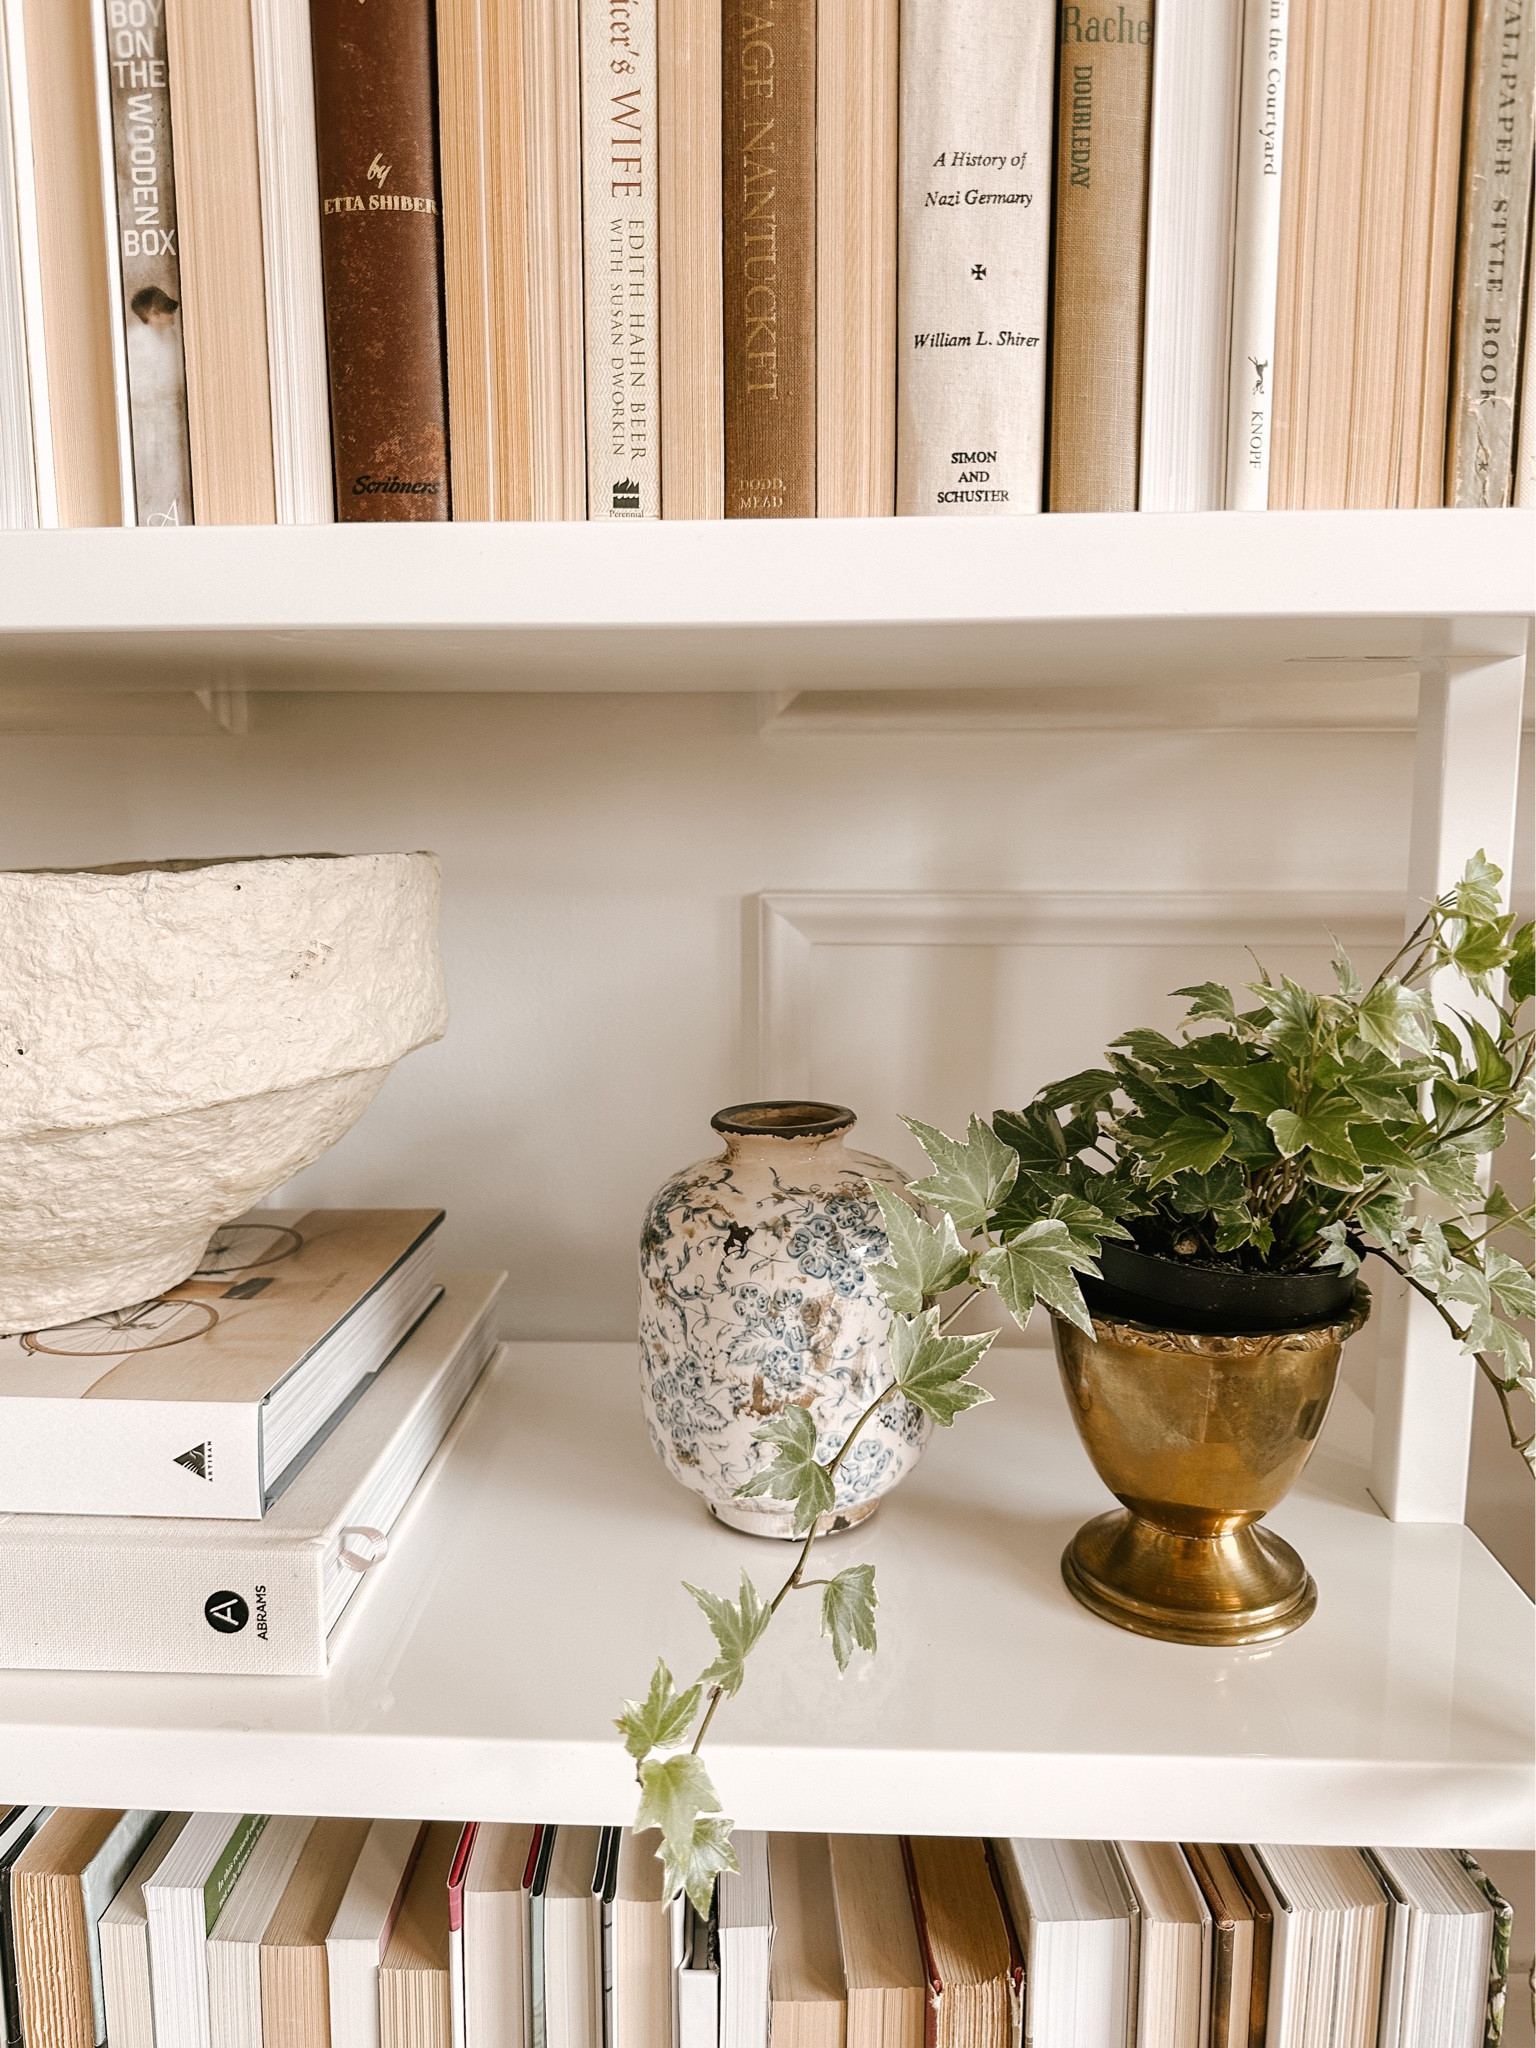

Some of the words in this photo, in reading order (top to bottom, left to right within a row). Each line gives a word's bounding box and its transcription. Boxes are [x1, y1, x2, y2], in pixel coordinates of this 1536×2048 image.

[110, 0, 163, 28] BOY
[1270, 0, 1285, 20] in
[116, 30, 156, 58] ON
[741, 0, 775, 100] AGE
[1268, 28, 1283, 61] the
[112, 60, 166, 88] THE
[610, 86, 642, 198] WIFE
[1070, 65, 1093, 189] DOUBLEDAY
[1259, 68, 1282, 176] Courtyard
[127, 93, 160, 225] WOODEN
[366, 152, 393, 189] by
[933, 152, 946, 167] A
[951, 151, 1007, 170] History
[1011, 152, 1028, 170] of
[324, 195, 366, 215] ETTA
[369, 194, 439, 215] SHIBER
[924, 191, 961, 207] Nazi
[965, 189, 1033, 208] Germany
[123, 229, 177, 257] BOX
[610, 218, 623, 272] WITH
[629, 220, 645, 297] EDITH
[742, 118, 779, 400] NANTUCKET
[1486, 200, 1508, 292] STYLE
[610, 283, 624, 346] SUSAN
[914, 332, 972, 349] William
[976, 331, 992, 346] L.
[997, 331, 1040, 347] Shirer
[630, 314, 646, 387] HAHN
[1480, 317, 1502, 408] BOOK
[611, 357, 625, 456] DWORKIN
[630, 403, 647, 460] BEER
[951, 451, 997, 464] SIMON
[1249, 411, 1264, 469] KNOPF
[937, 490, 1009, 503] SCHUSTER
[958, 471, 990, 483] AND
[609, 510, 644, 518] Perennial
[255, 1585, 268, 1640] ABRAMS
